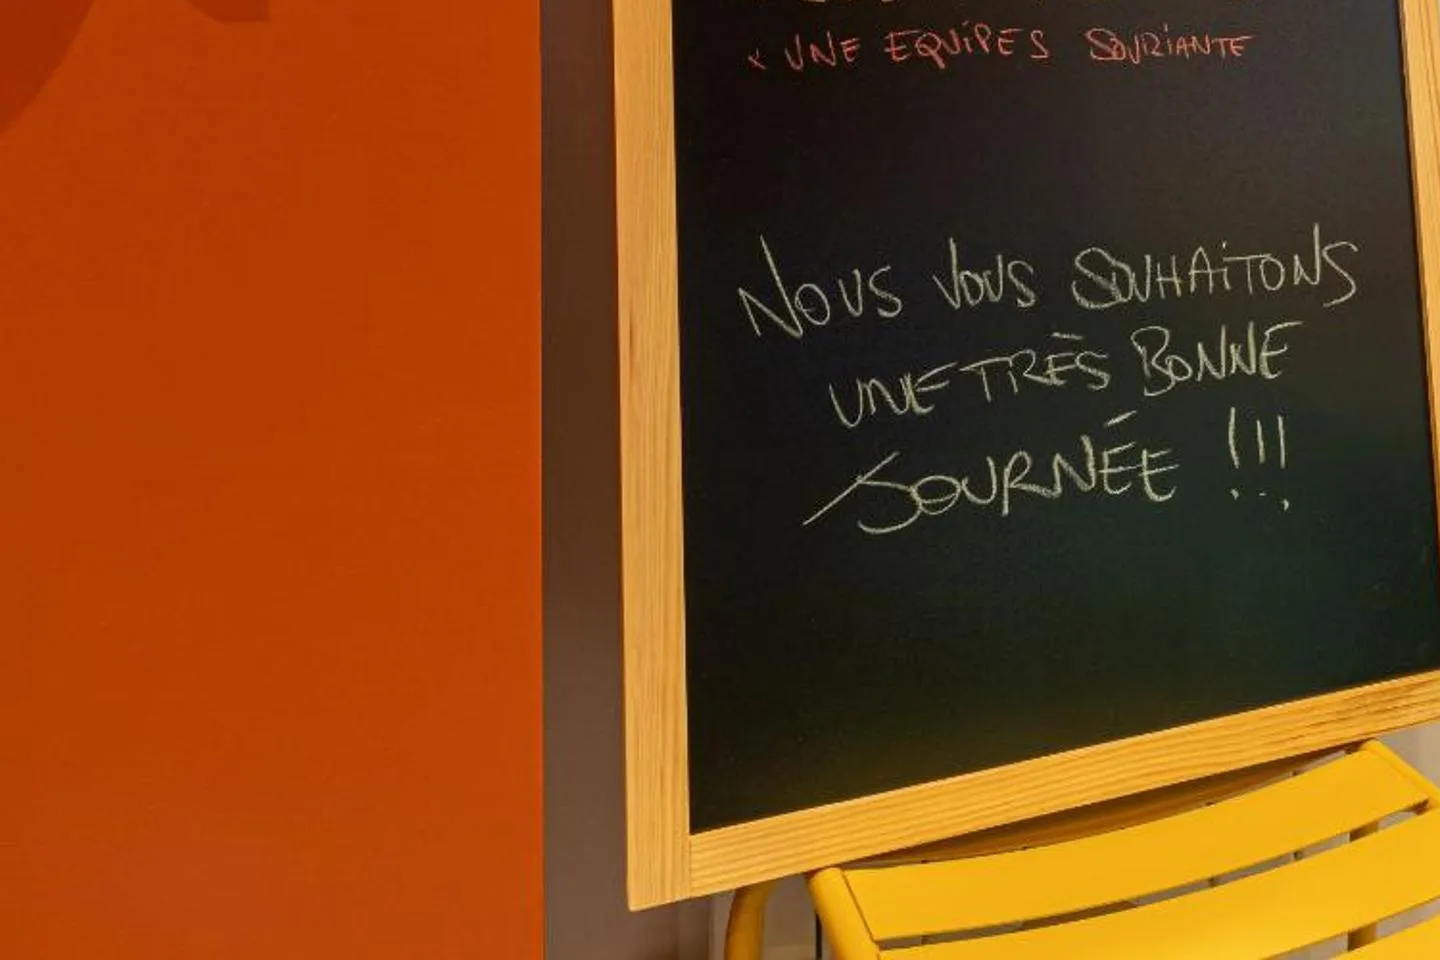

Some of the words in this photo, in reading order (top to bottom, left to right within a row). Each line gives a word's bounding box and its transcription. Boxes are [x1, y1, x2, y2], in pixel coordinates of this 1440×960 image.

[784, 29, 861, 72] UNE
[738, 235, 903, 339] NOUS
[934, 237, 1036, 309] VOUS
[829, 362, 955, 428] UNE
[1131, 320, 1302, 397] BONNE
